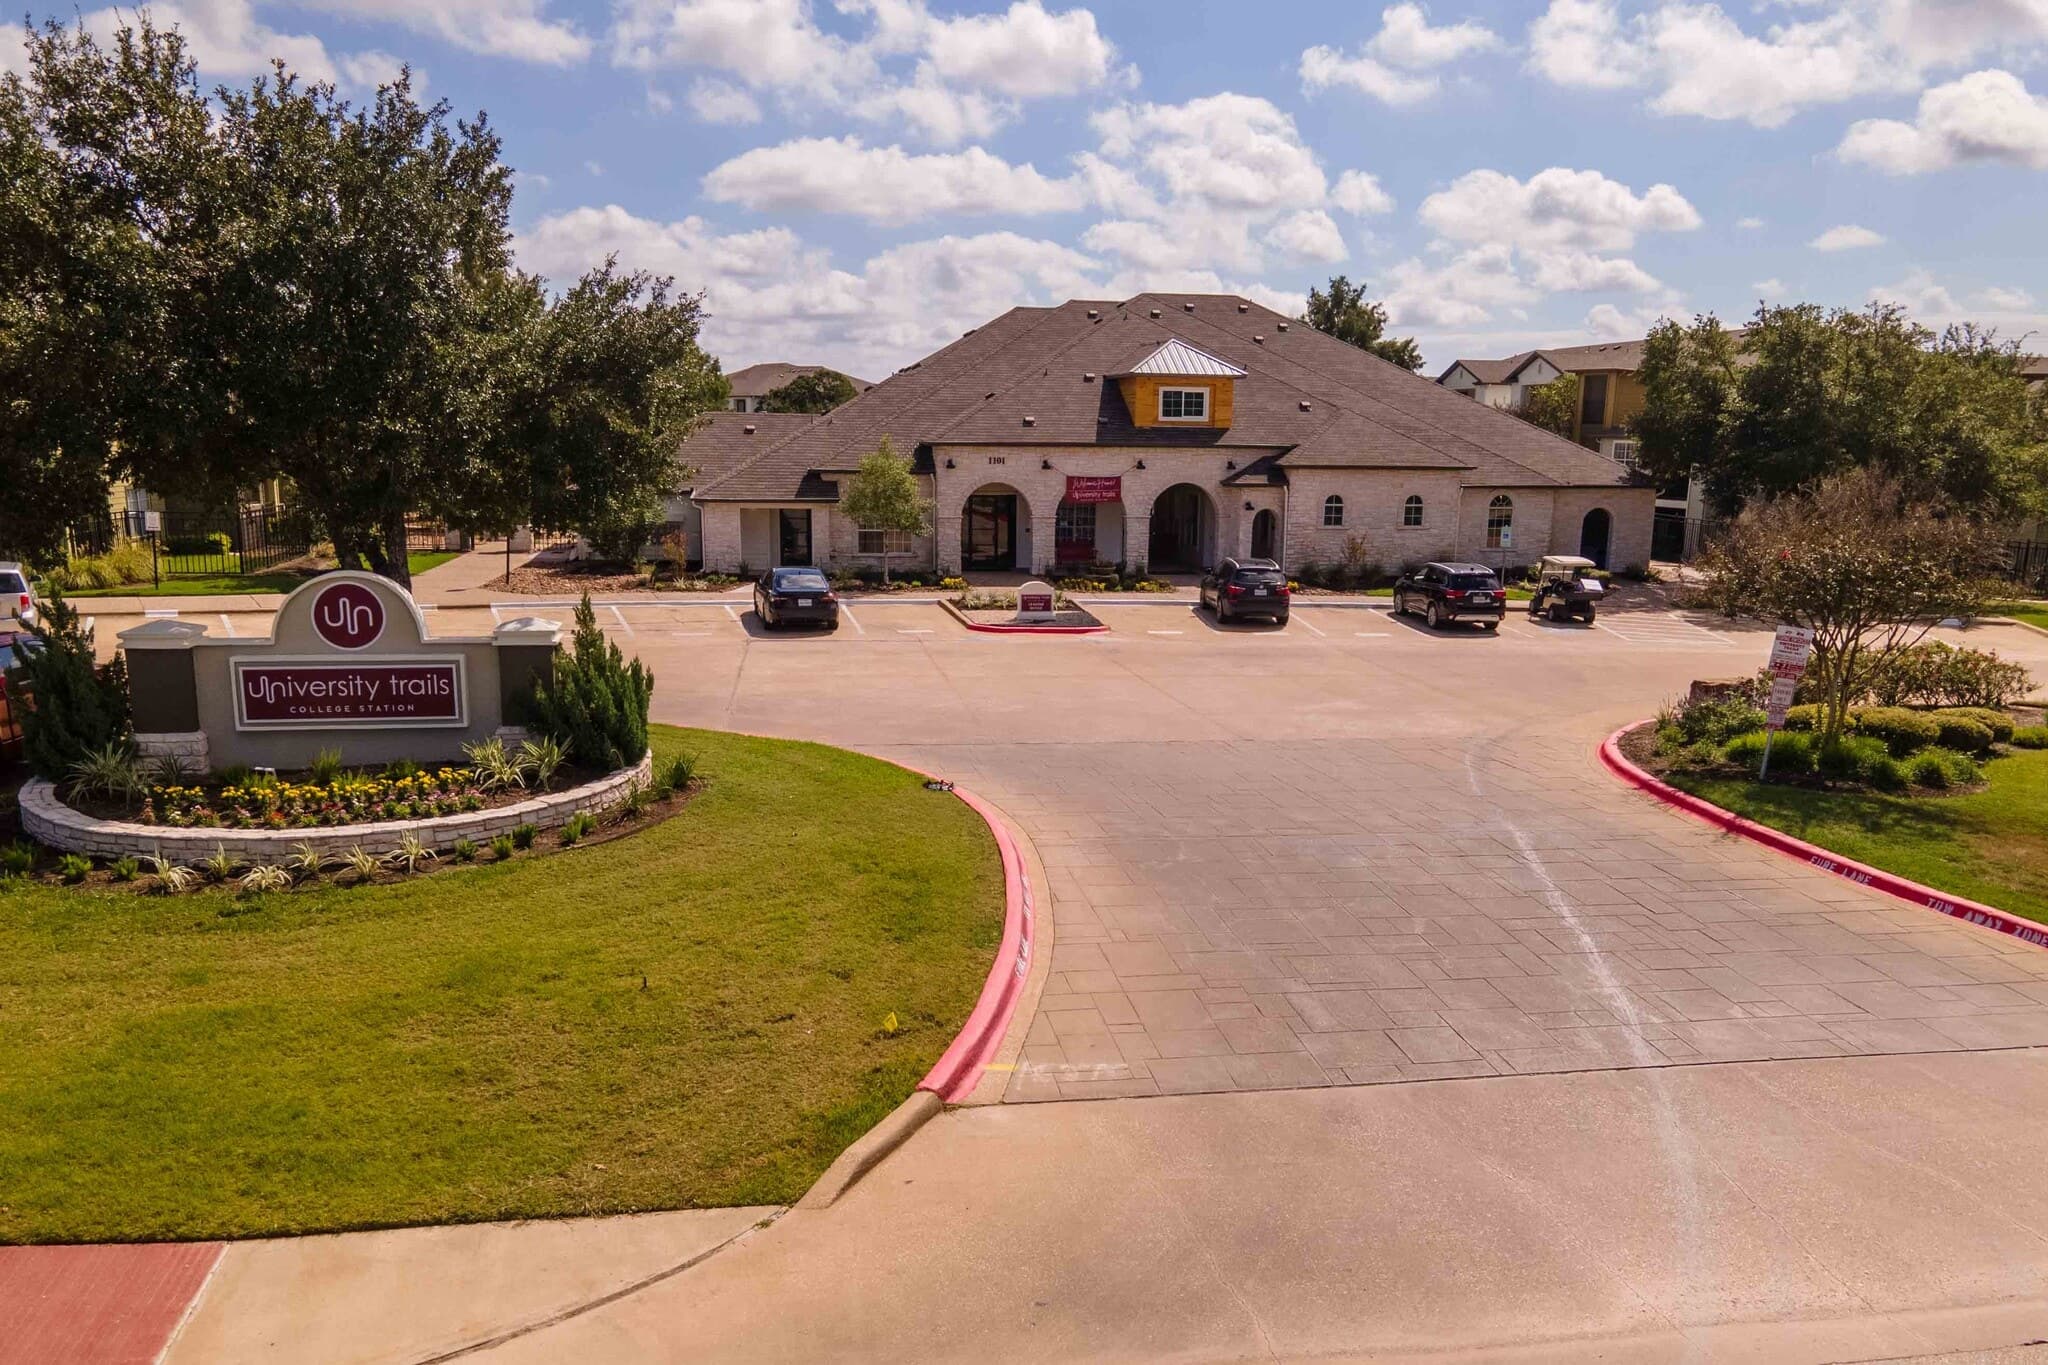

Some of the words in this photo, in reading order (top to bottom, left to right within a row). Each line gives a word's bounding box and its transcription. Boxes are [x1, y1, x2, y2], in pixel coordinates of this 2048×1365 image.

[988, 456, 1005, 465] 1101
[389, 674, 450, 696] trails
[289, 704, 351, 714] COLLEGE
[359, 703, 416, 713] STATION
[1842, 867, 1873, 886] LANE
[1926, 897, 1955, 914] TOW
[1963, 911, 2003, 930] AWAY
[2012, 925, 2048, 947] ZONE
